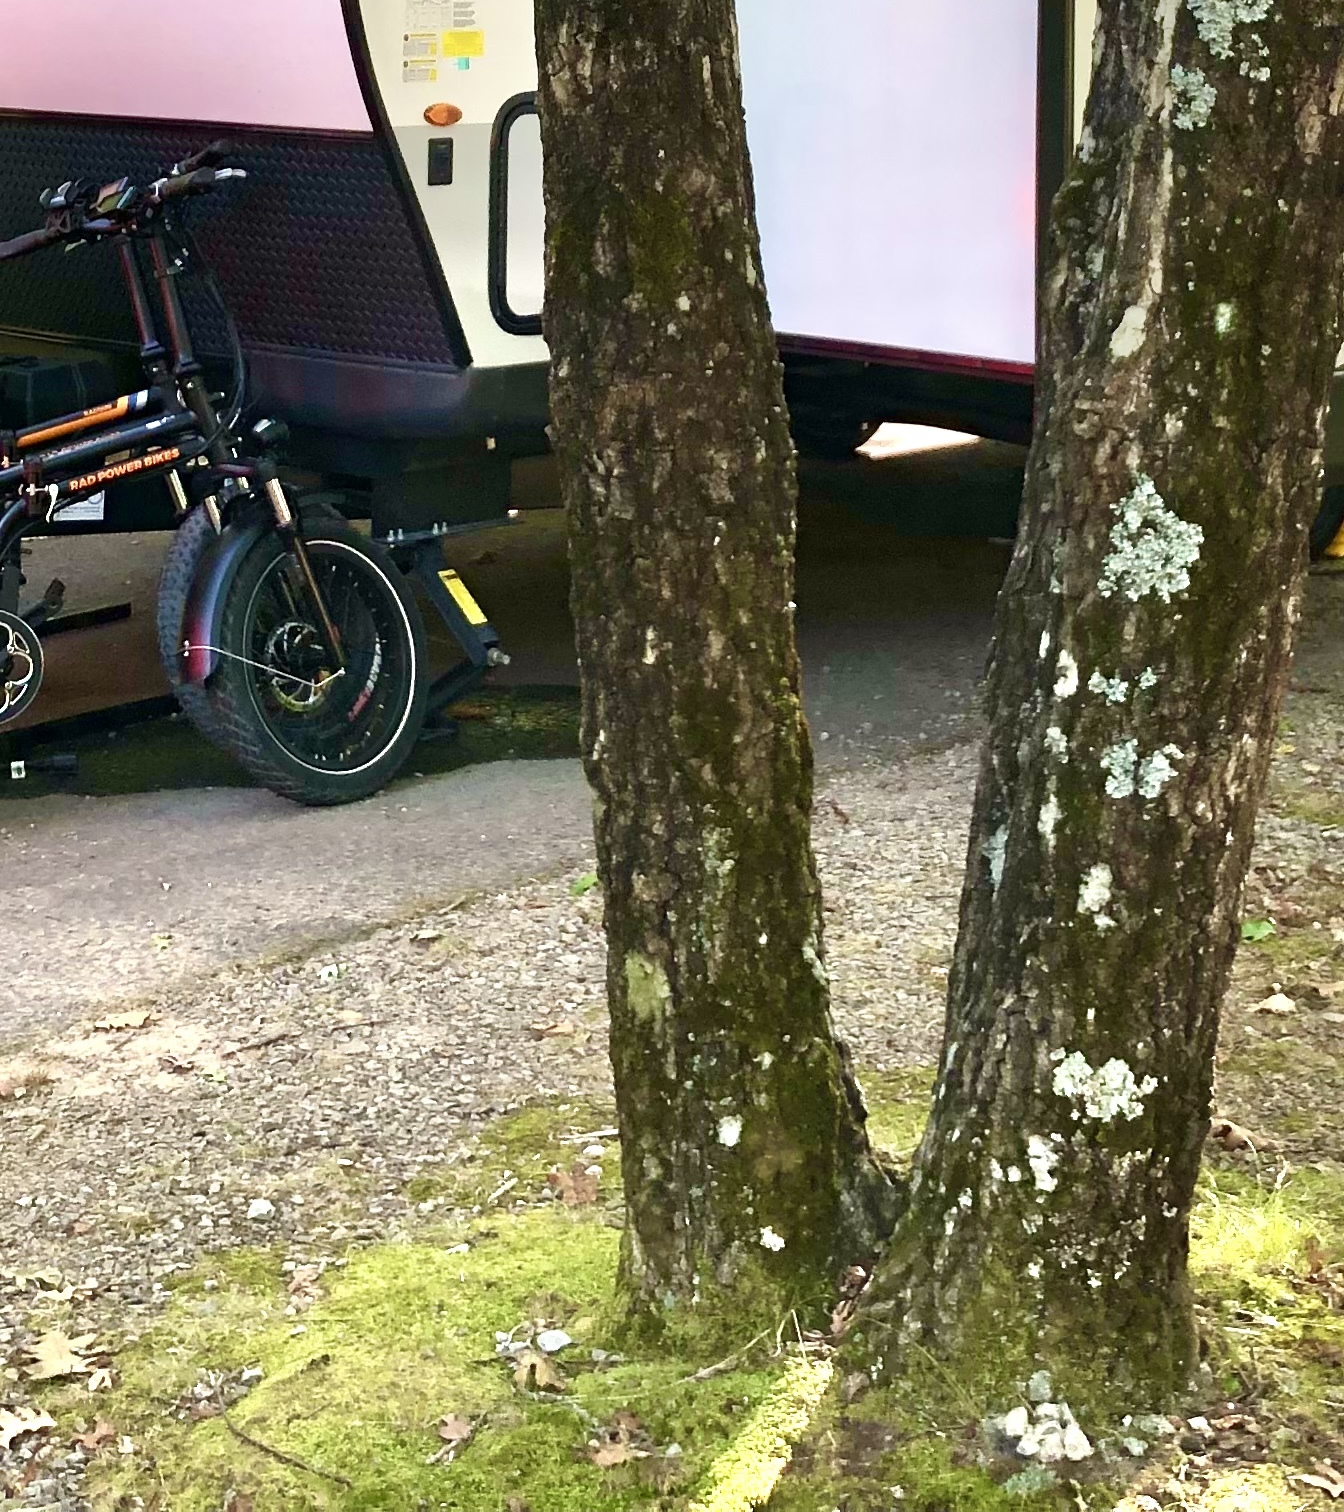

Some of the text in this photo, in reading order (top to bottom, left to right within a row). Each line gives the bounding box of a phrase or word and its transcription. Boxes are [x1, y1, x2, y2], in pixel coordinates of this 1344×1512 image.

[69, 448, 180, 491] RAD POWER BIKES
